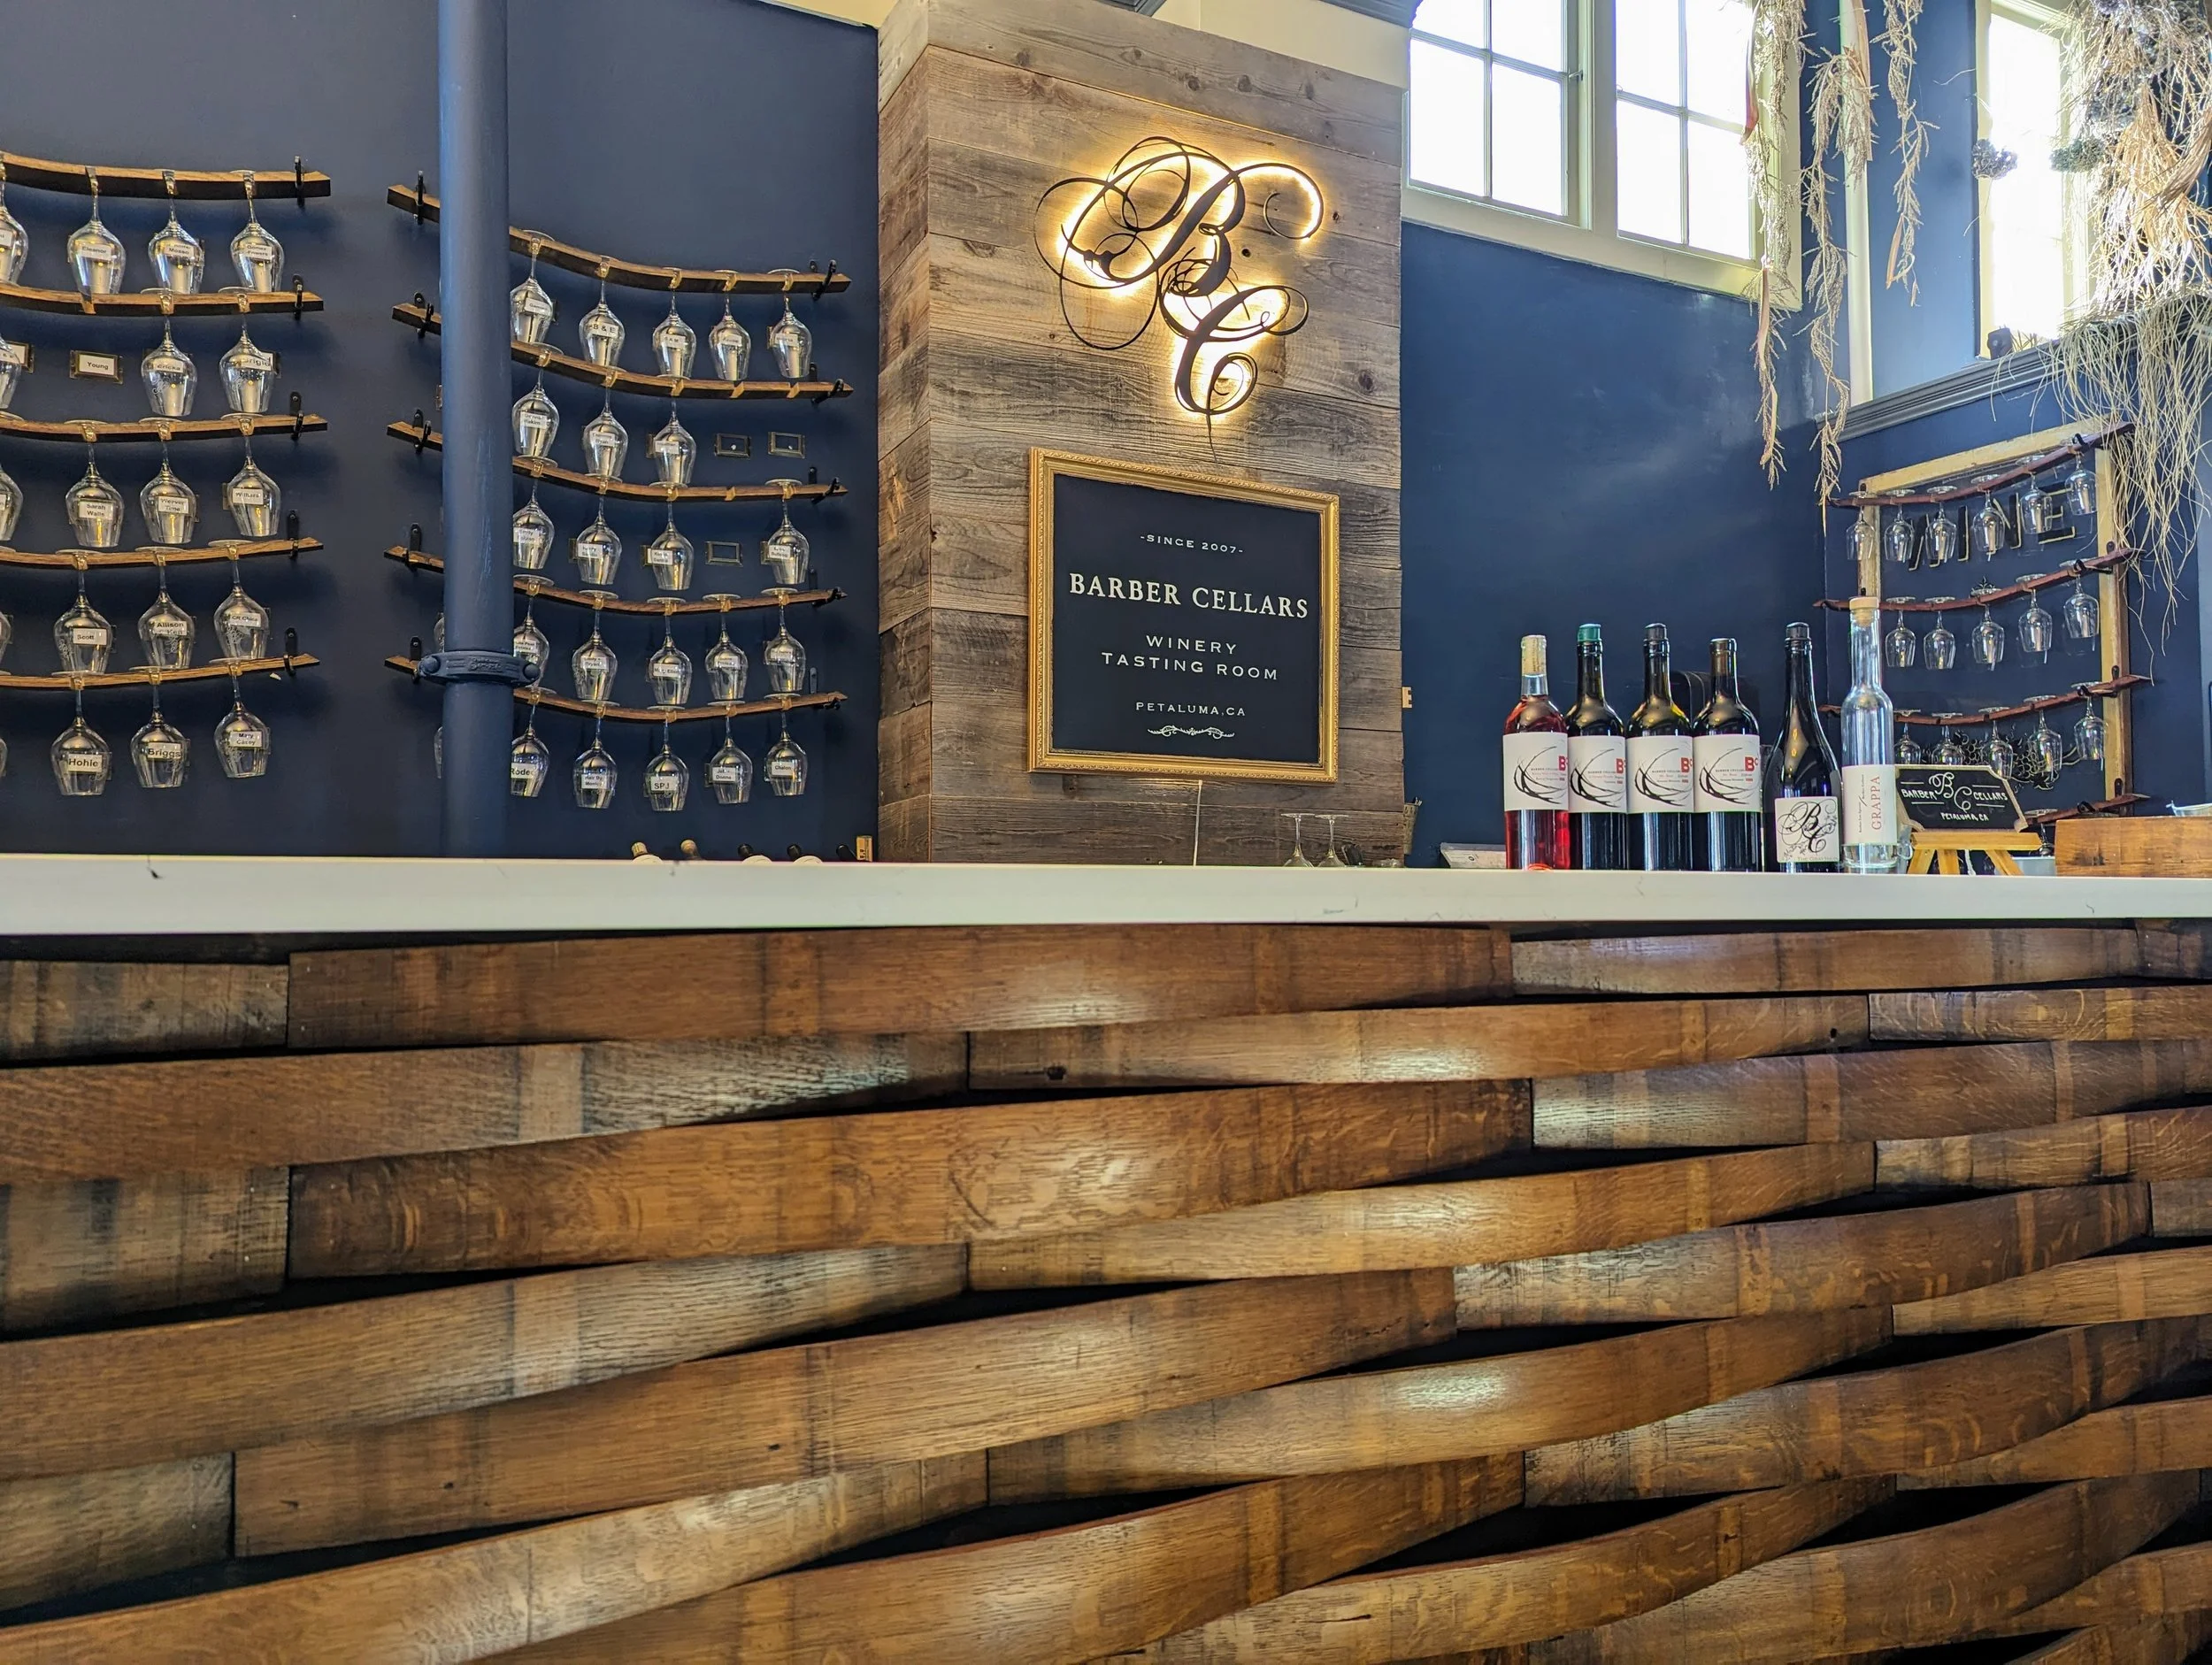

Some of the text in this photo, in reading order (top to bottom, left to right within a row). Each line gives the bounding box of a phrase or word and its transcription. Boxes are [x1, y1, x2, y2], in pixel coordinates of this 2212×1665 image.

[87, 361, 109, 370] Young
[1069, 572, 1309, 618] BARBER CELLARS
[1146, 634, 1237, 655] WINERY
[1101, 652, 1278, 680] TASTING ROOM
[148, 748, 181, 758] Briggs
[68, 758, 98, 767] Hohle
[1870, 776, 1882, 830] GRAPPA
[1901, 789, 1937, 800] BARBER
[1973, 792, 2008, 801] CELLARS
